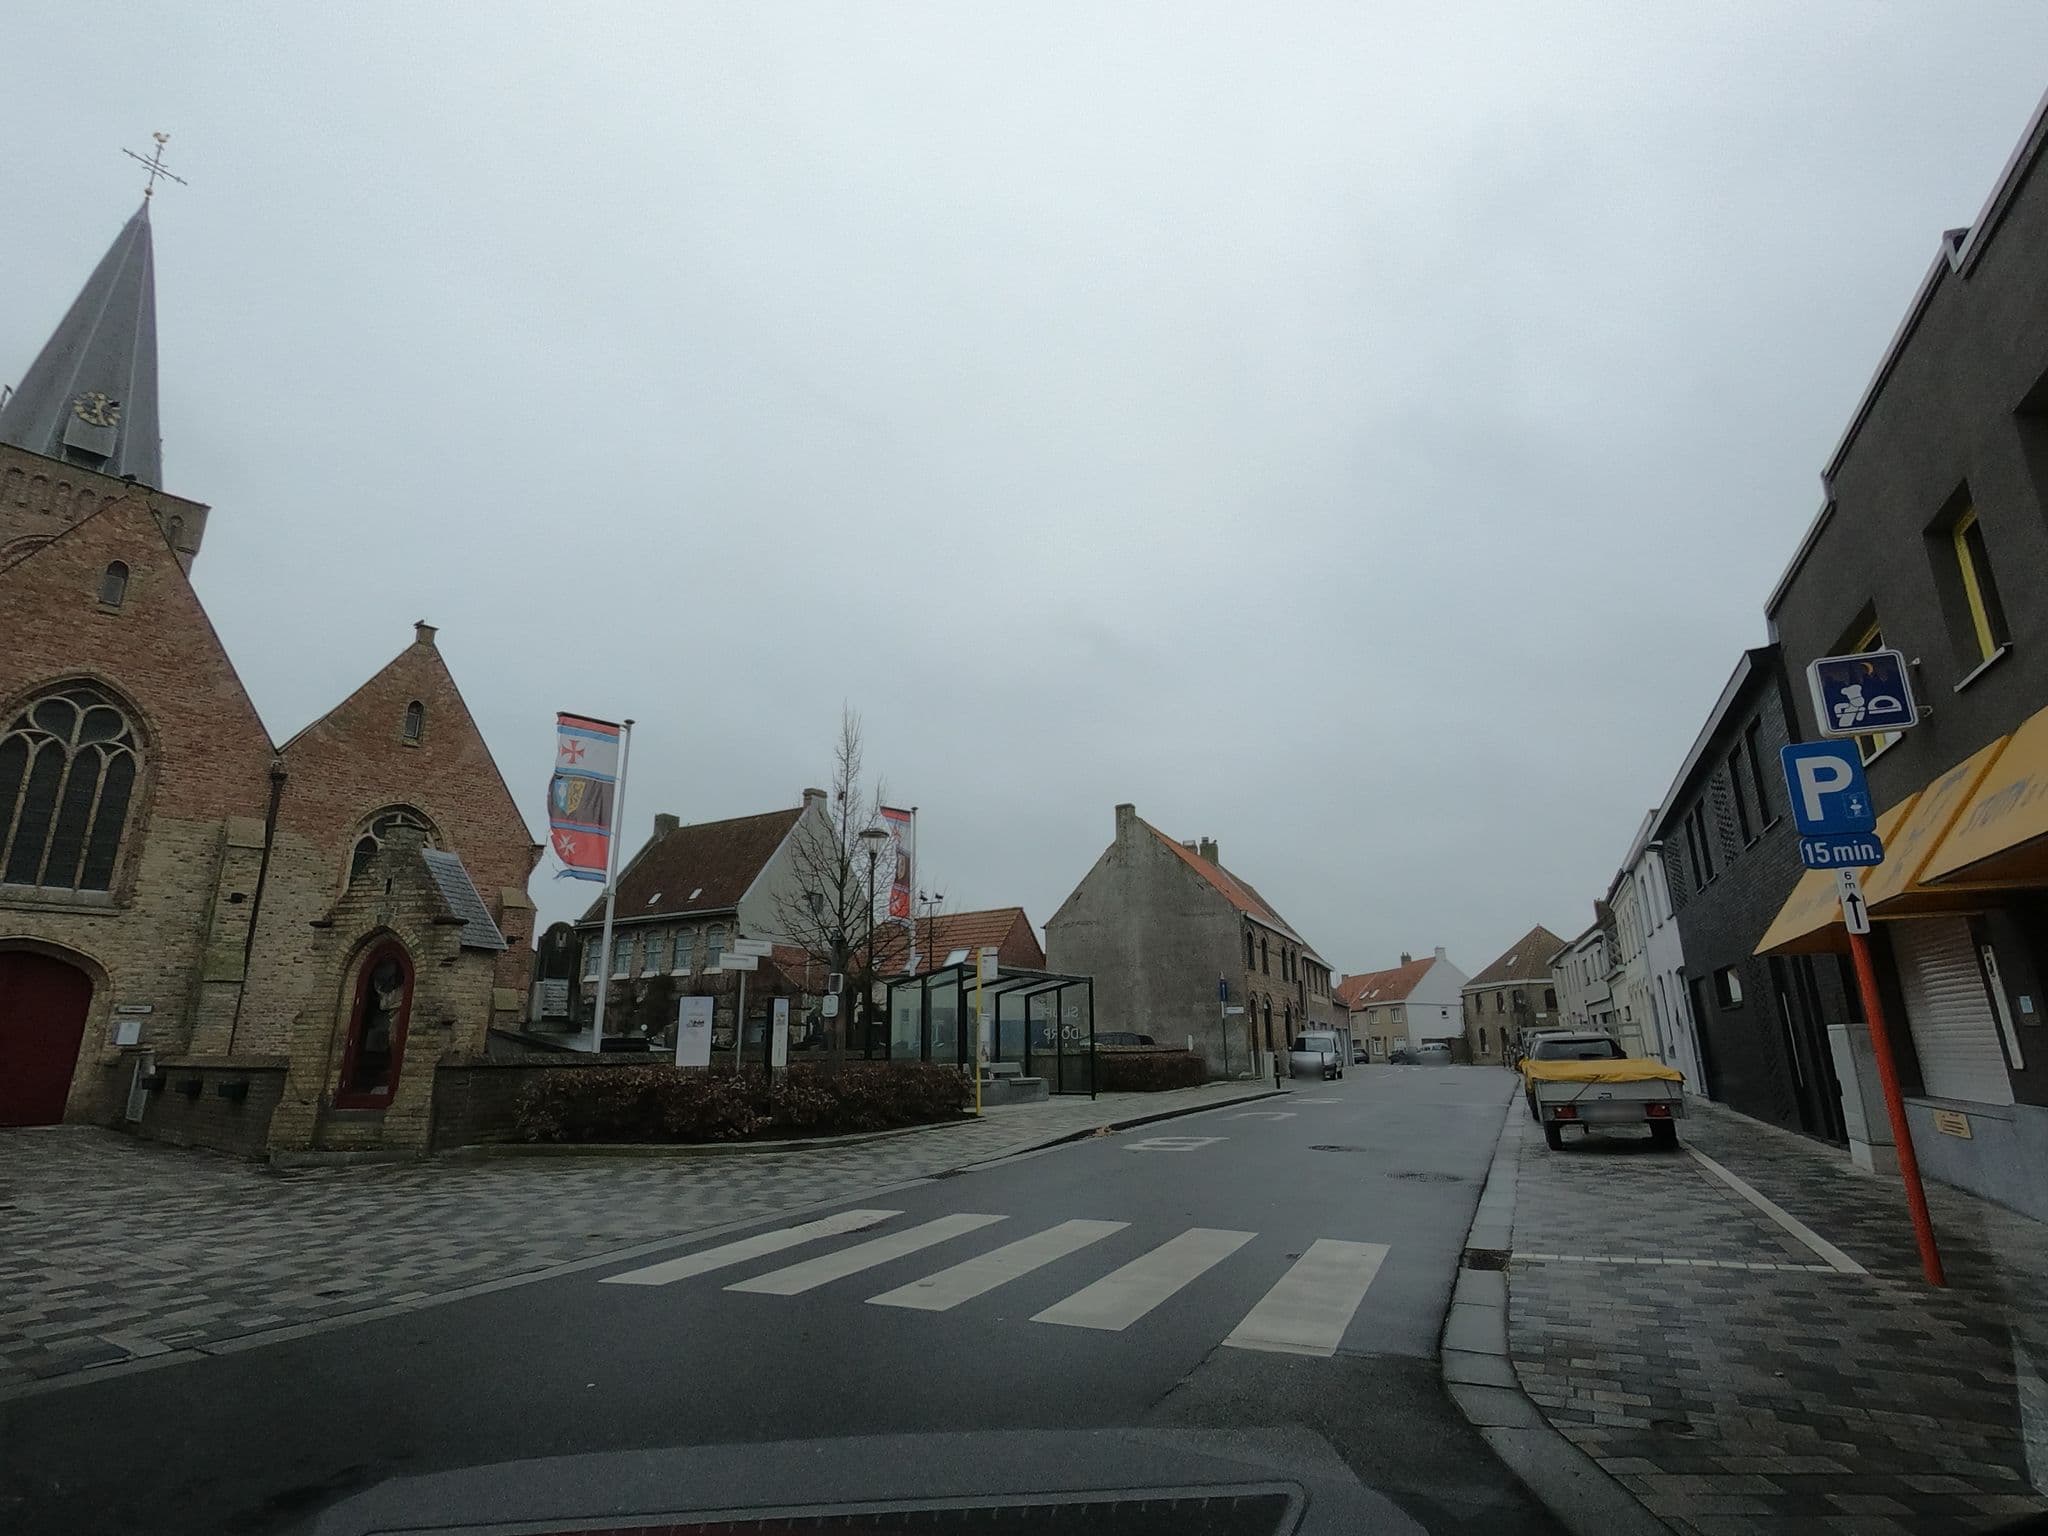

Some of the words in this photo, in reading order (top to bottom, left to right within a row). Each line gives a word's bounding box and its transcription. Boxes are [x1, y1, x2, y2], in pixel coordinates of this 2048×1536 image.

[1795, 755, 1853, 821] P
[1805, 842, 1831, 863] 15
[1833, 840, 1881, 862] min.
[1844, 871, 1852, 880] 6
